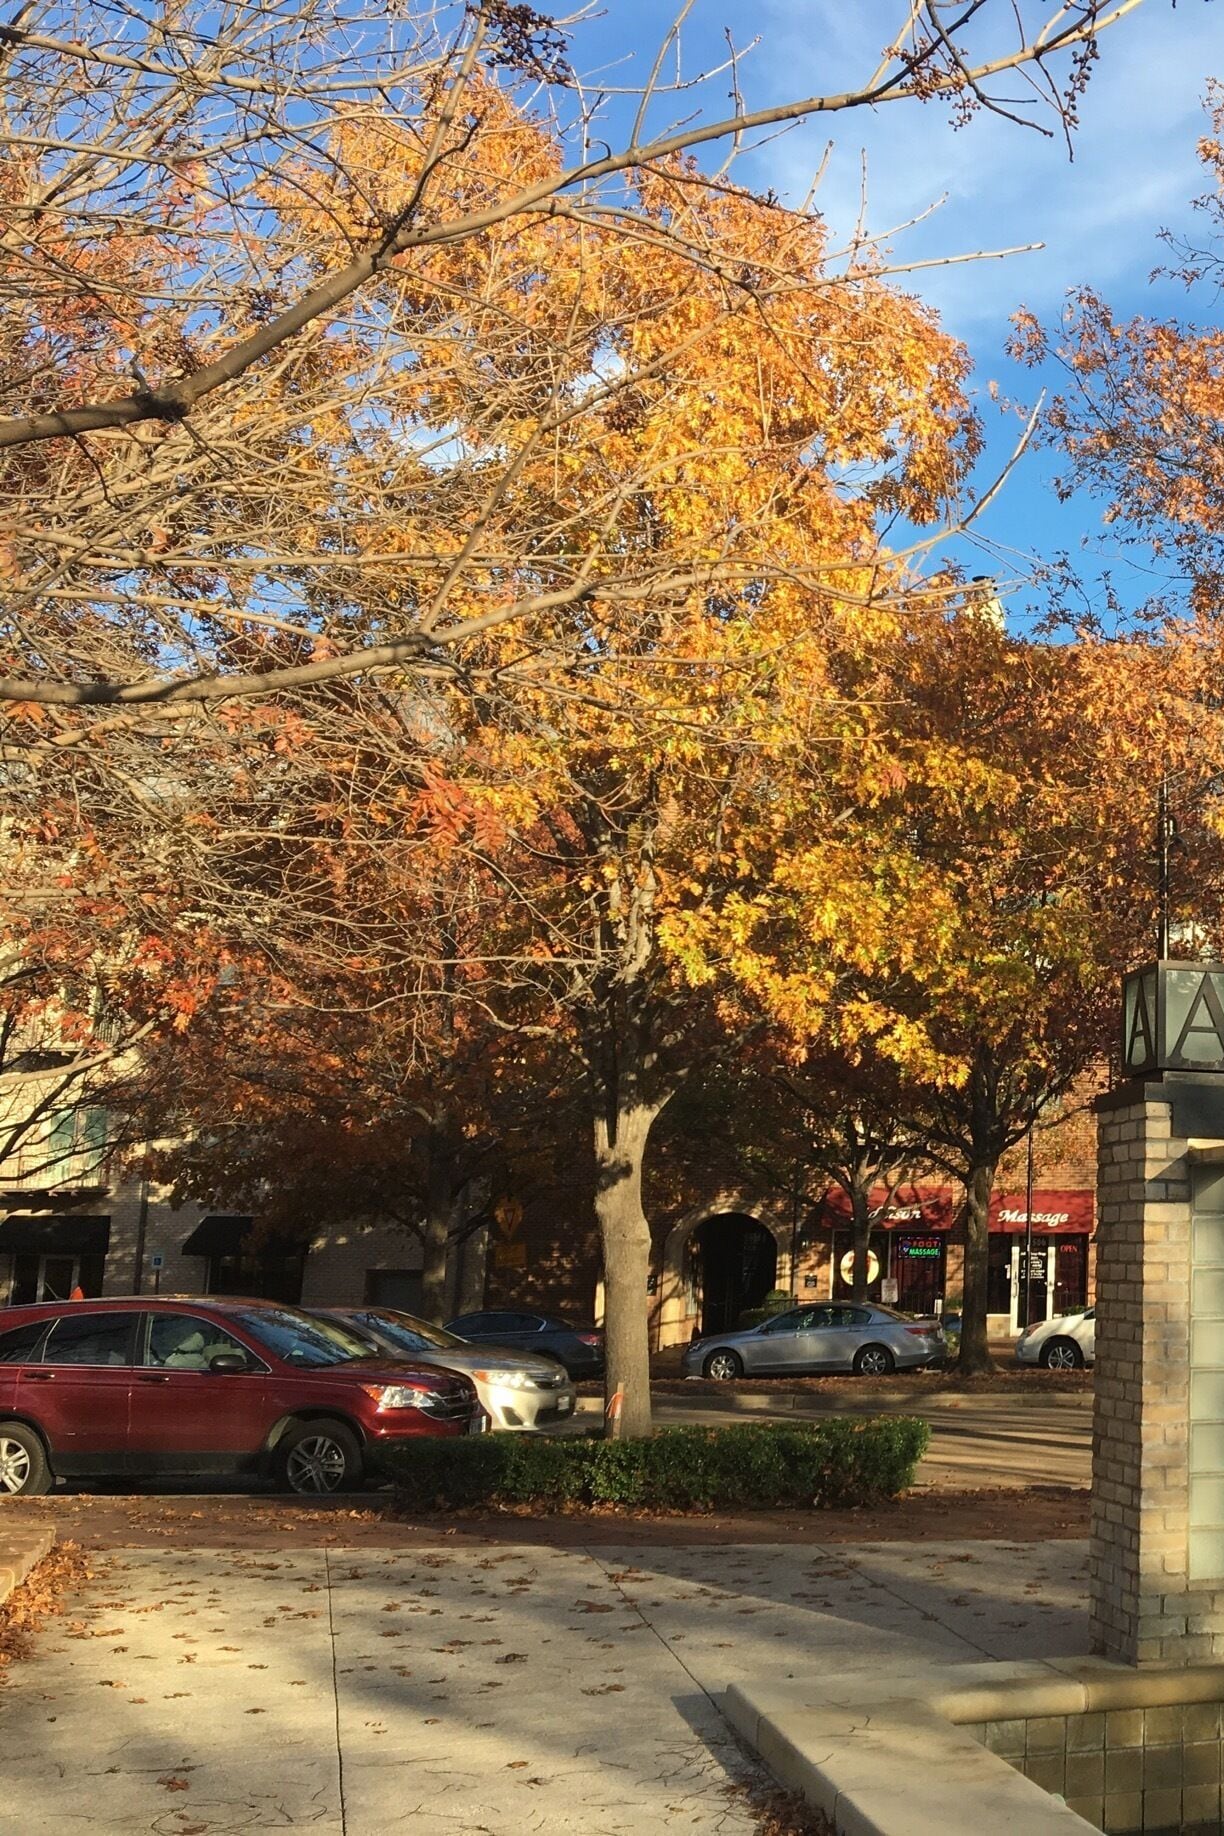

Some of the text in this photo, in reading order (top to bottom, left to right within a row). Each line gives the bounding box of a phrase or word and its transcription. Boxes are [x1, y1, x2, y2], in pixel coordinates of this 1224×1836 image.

[1126, 974, 1155, 1066] A
[997, 1209, 1070, 1227] Massage
[908, 1248, 939, 1256] MASSAGE
[1060, 1244, 1078, 1253] OPEN
